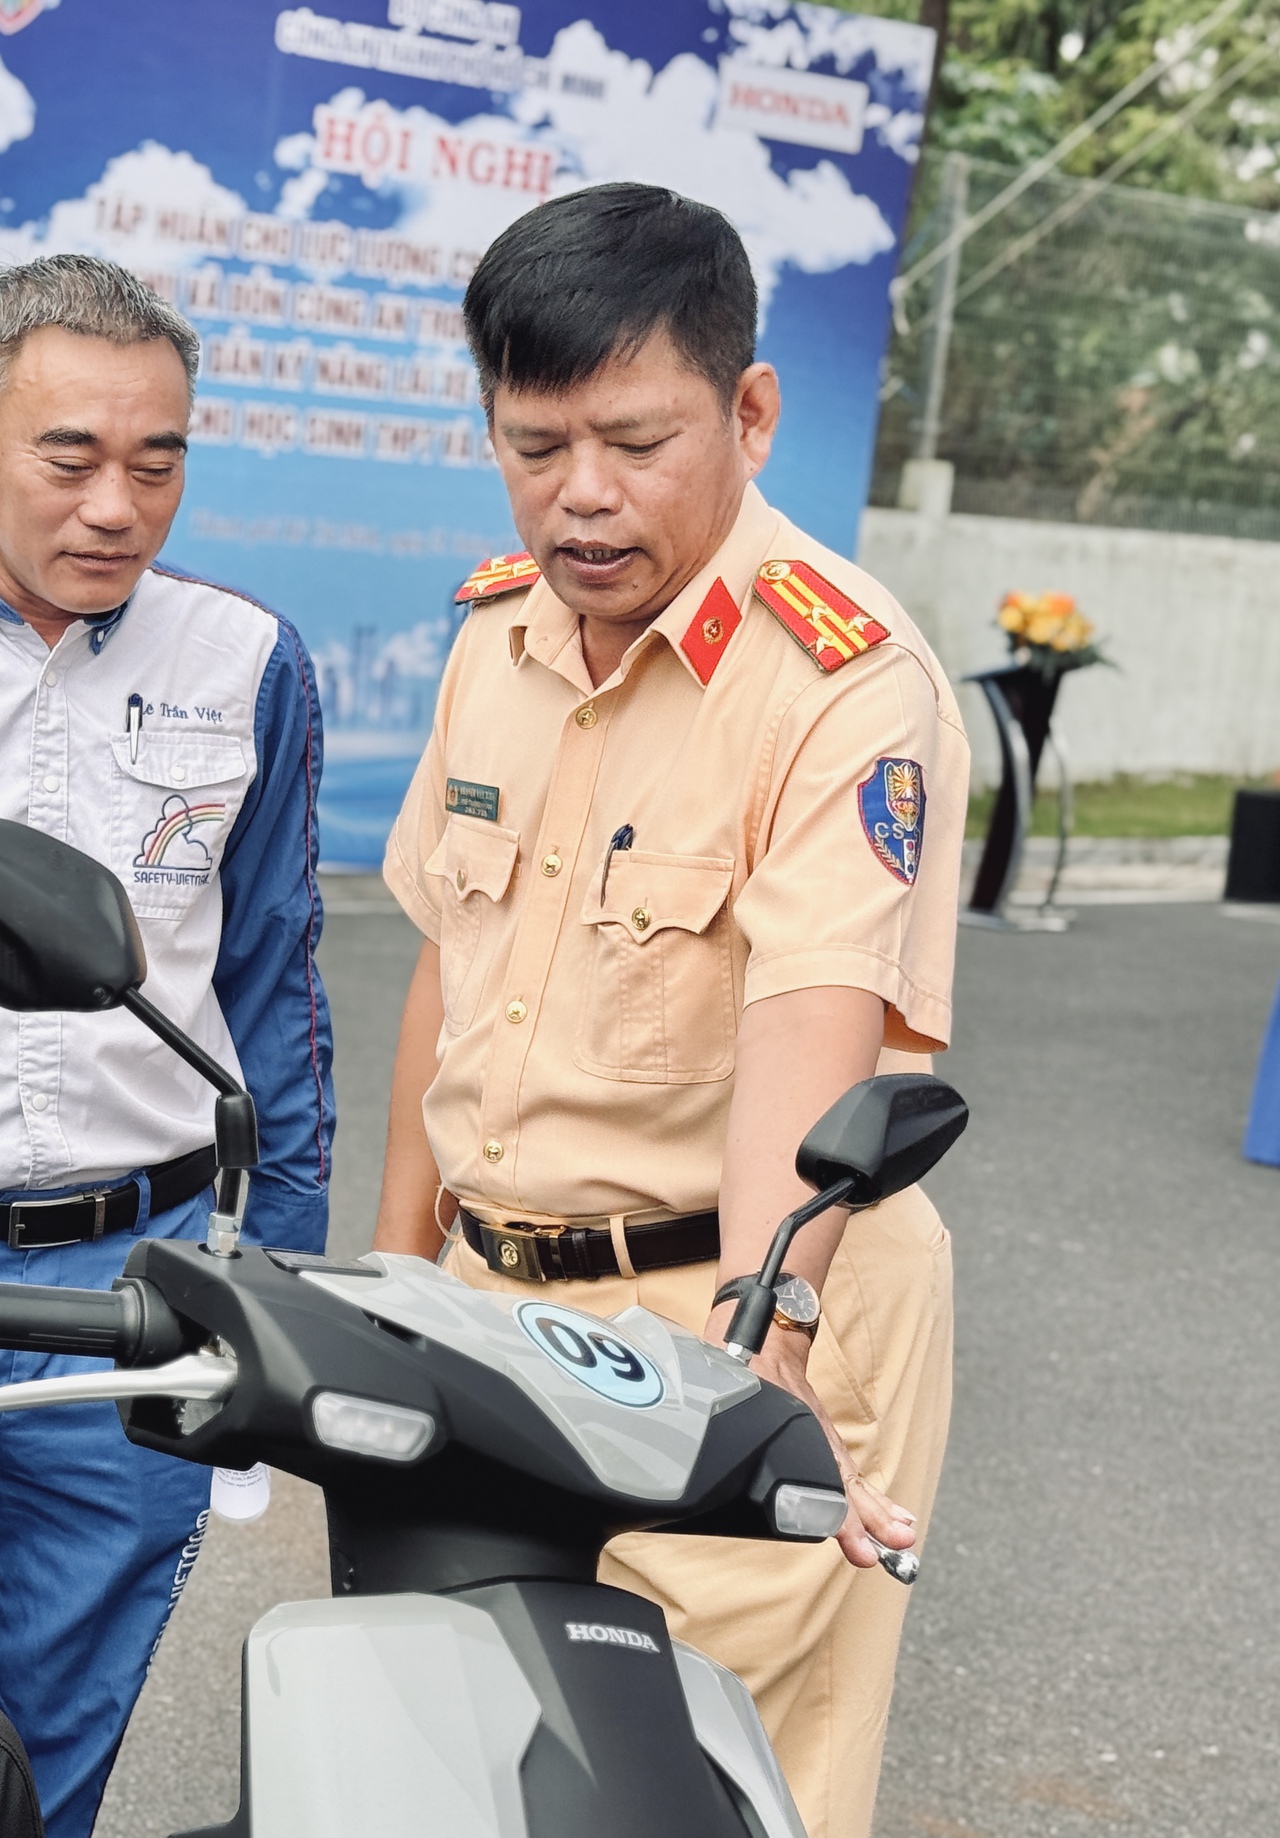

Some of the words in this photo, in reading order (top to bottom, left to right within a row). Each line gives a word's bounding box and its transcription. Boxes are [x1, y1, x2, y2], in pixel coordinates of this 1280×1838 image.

[730, 81, 852, 129] HONDA
[535, 1317, 646, 1383] 09
[565, 1624, 661, 1653] HONDA
